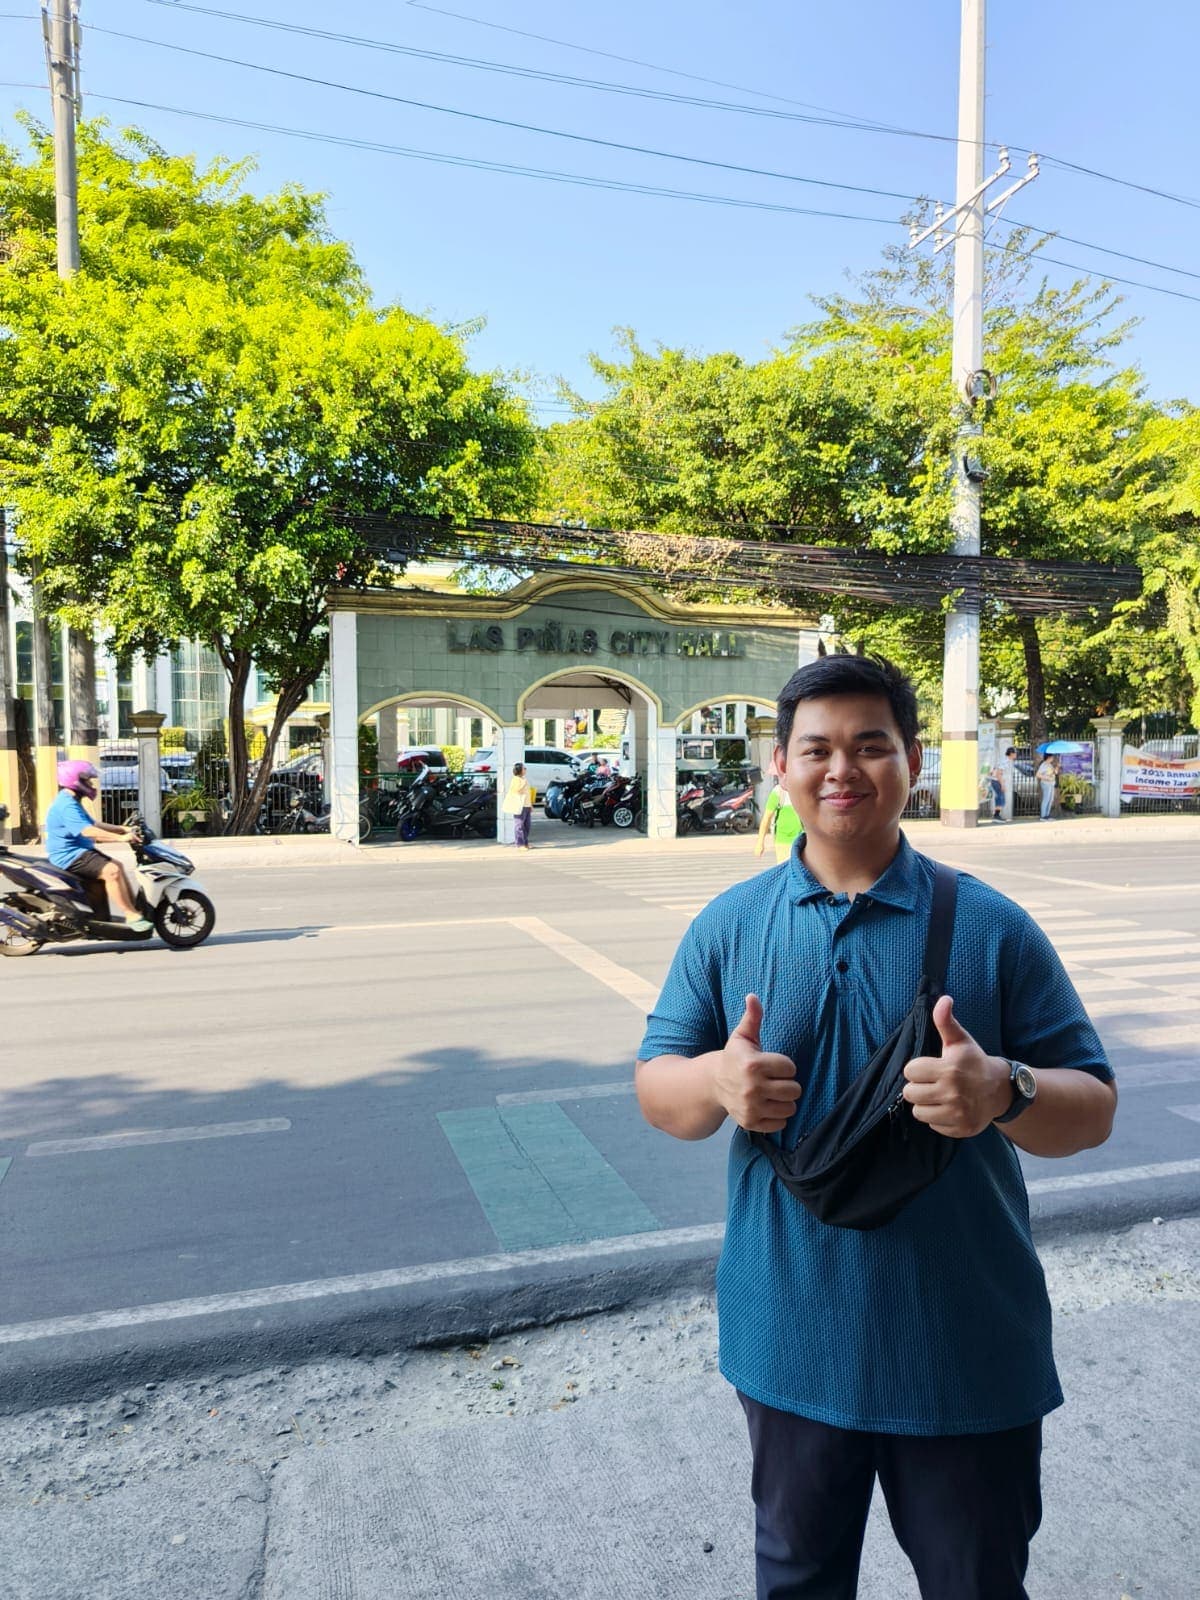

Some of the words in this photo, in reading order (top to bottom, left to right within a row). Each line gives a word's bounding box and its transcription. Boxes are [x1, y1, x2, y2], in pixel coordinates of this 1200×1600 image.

[448, 623, 504, 652] LAS
[610, 631, 670, 656] CITY
[1135, 776, 1171, 786] Income
